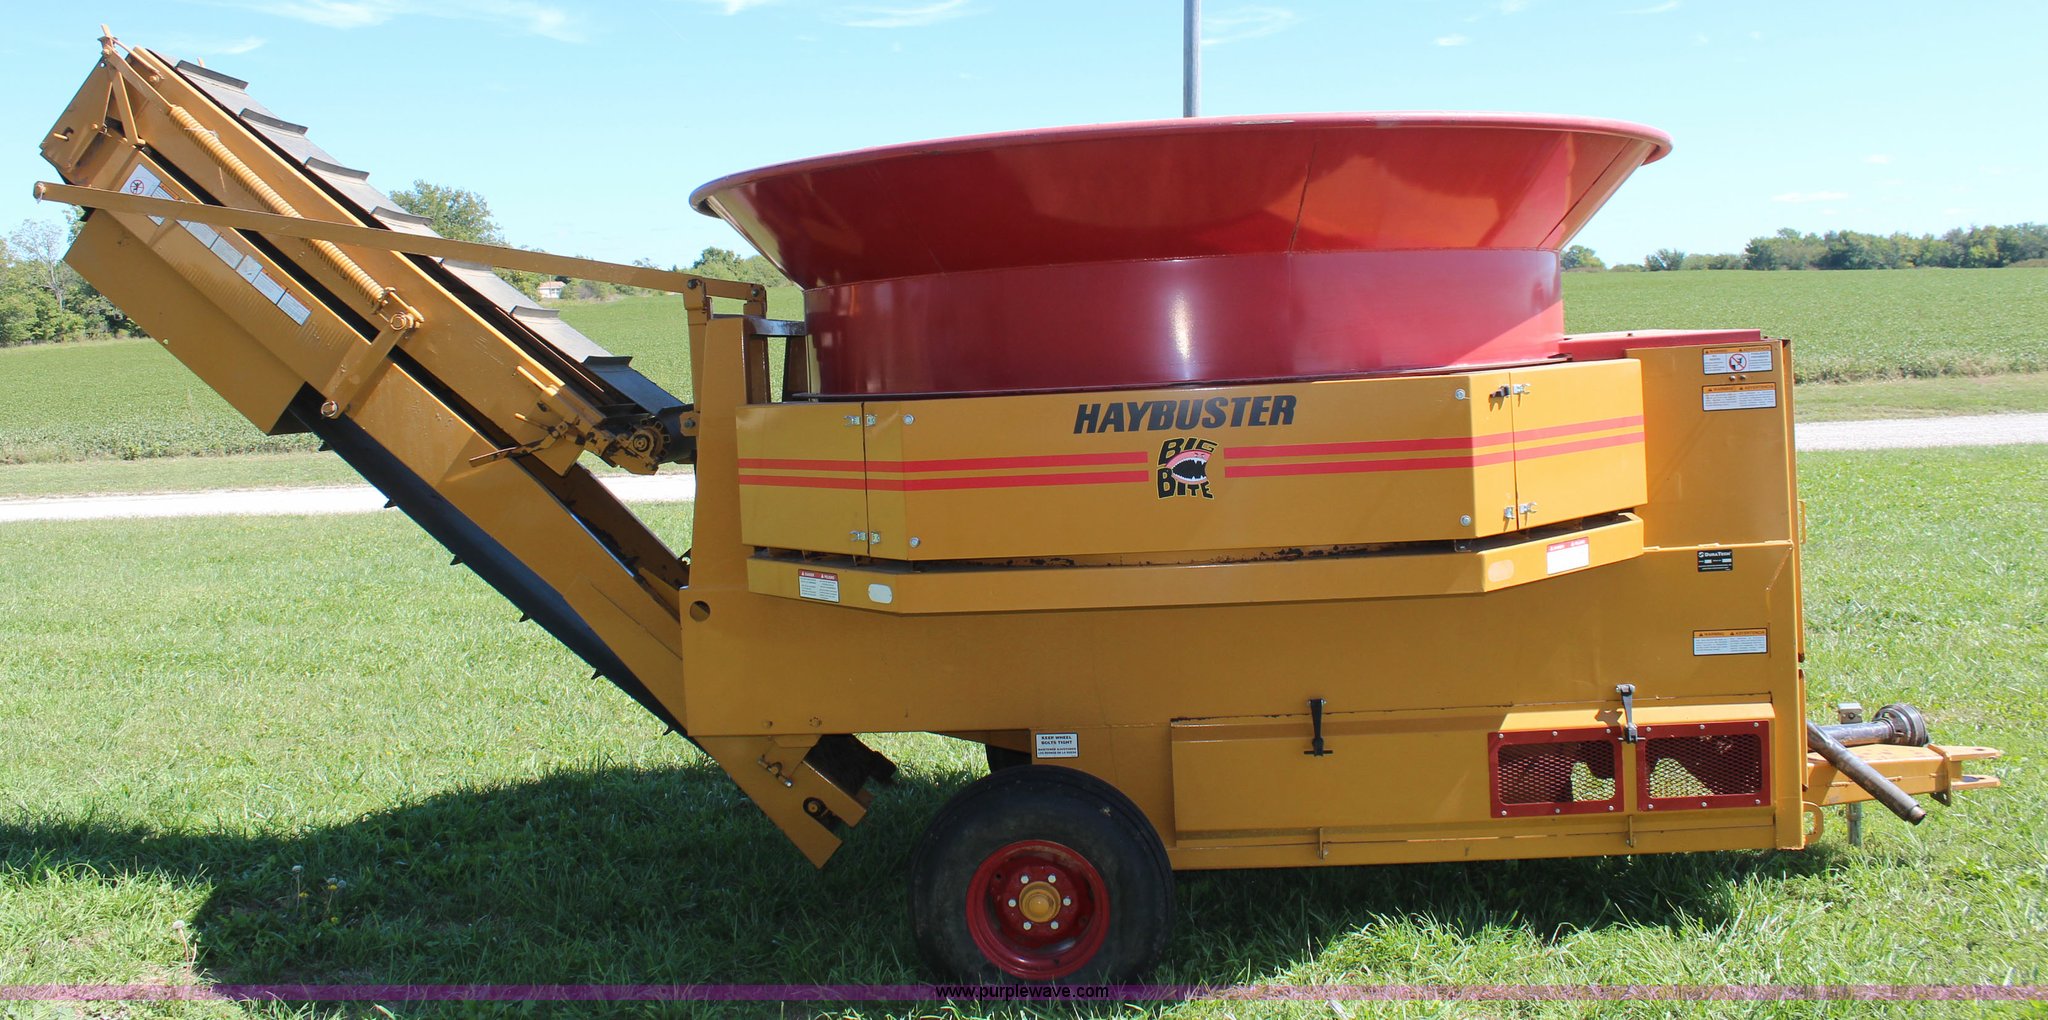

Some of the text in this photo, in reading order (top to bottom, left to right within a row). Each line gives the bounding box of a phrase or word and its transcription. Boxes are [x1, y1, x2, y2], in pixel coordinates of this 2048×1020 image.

[1073, 394, 1297, 434] HAYBUSTER
[1157, 437, 1218, 467] BIG
[1157, 467, 1214, 499] BITE
